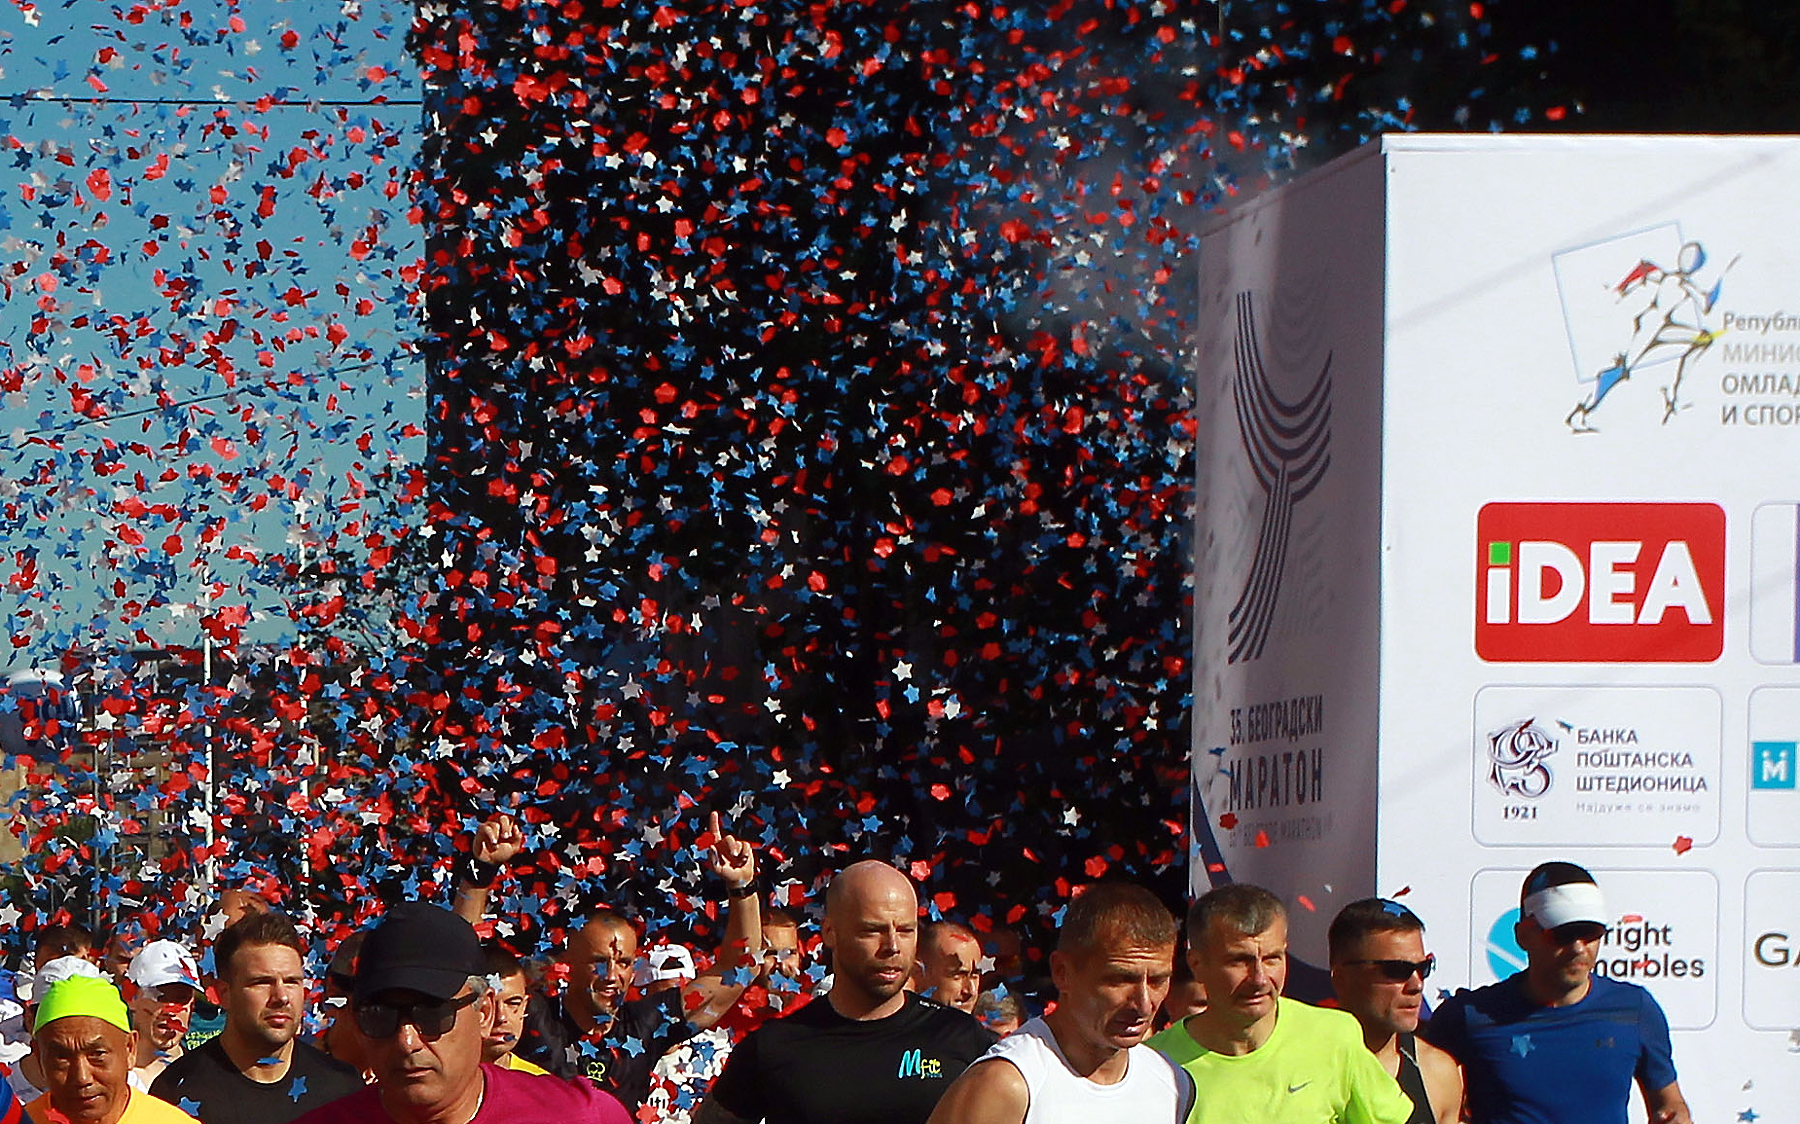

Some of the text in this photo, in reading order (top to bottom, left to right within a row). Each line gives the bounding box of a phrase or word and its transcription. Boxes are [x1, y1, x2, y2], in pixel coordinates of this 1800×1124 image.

[1723, 311, 1800, 335] Републ
[1723, 343, 1800, 362] МИНИ
[1722, 405, 1737, 425] И
[1248, 694, 1323, 743] БЕОГРАДСКИ
[1577, 729, 1638, 745] БАНКА
[1576, 751, 1693, 768] ПОШТАНСКА
[1229, 748, 1322, 812] МАРАТОН
[1576, 776, 1708, 794] ШТЕДИОНИЦА
[1503, 806, 1538, 820] 1921
[1603, 921, 1673, 952] right
